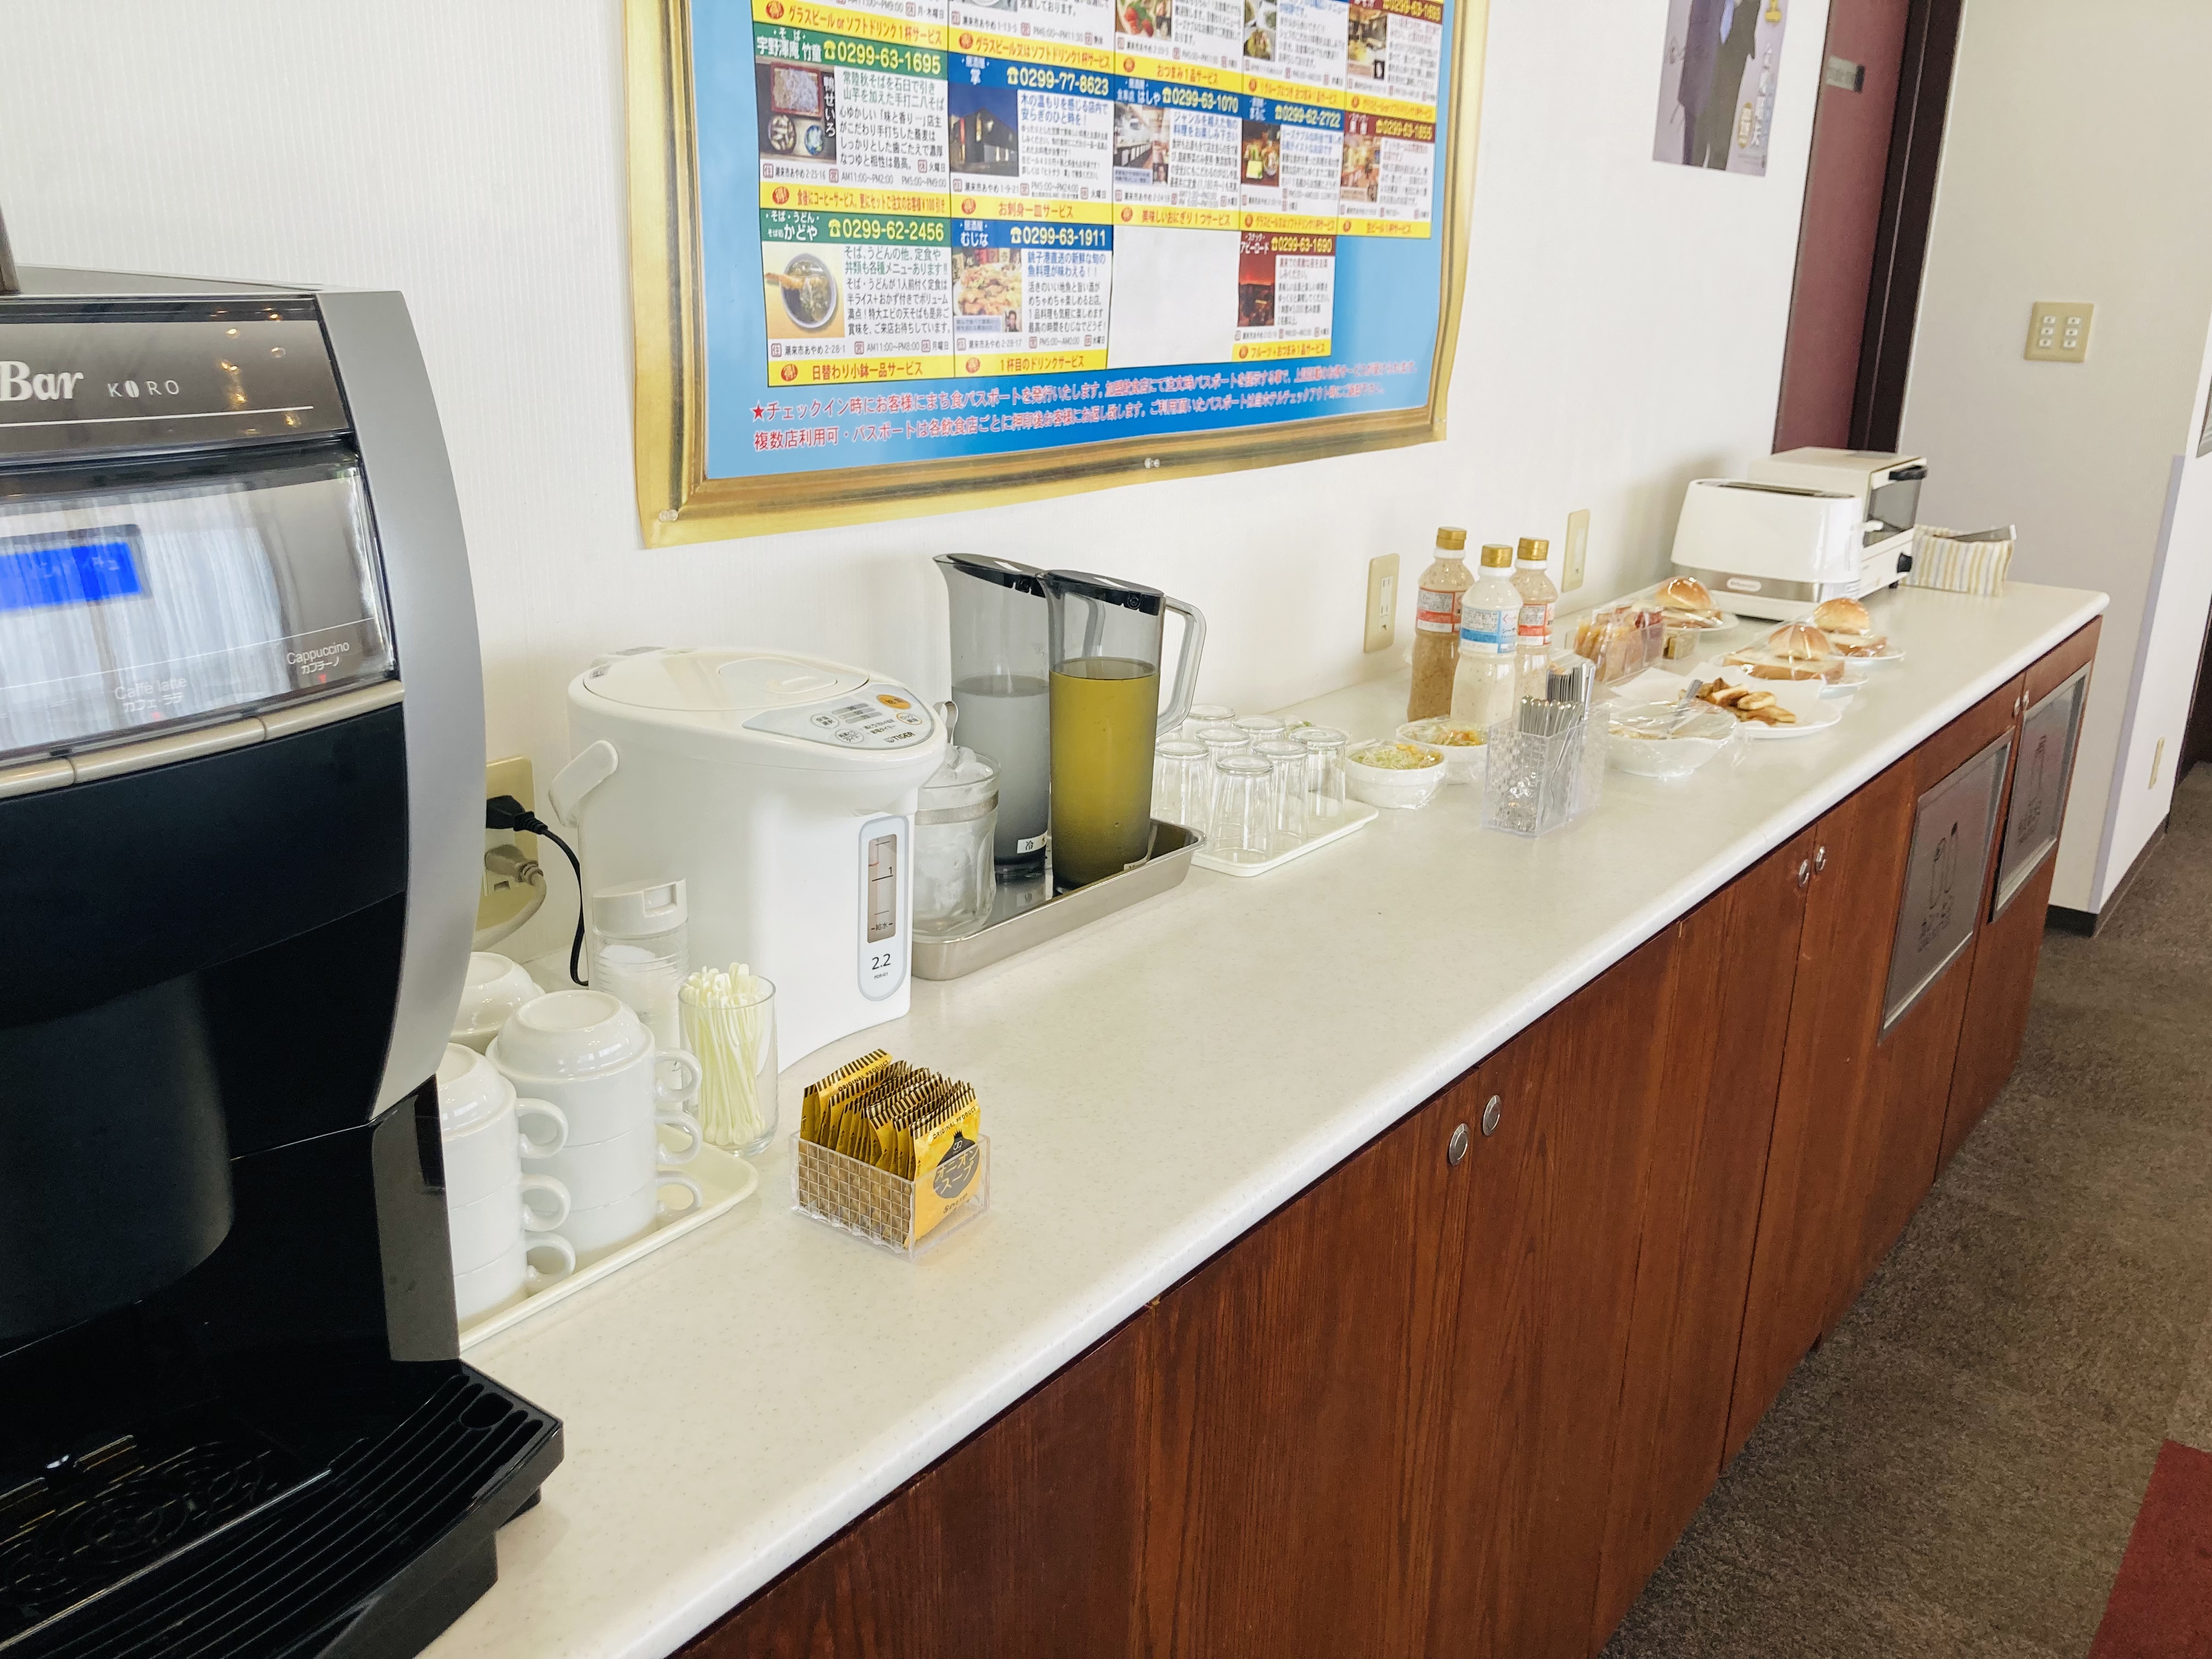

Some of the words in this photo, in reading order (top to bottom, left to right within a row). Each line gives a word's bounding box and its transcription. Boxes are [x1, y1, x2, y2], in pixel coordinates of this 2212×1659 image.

[837, 41, 942, 75] 0299-63-1695
[1020, 66, 1109, 96] 0299-77-8623
[842, 218, 944, 241] 0299-62-2456
[960, 231, 989, 247] むじな
[1023, 225, 1106, 247] 0299-63-1911
[0, 360, 84, 402] Bar
[812, 362, 923, 381] 日替わり小鉢一品サービス
[286, 641, 350, 665] Cappuccino
[892, 731, 916, 741] TIGER
[888, 866, 893, 874] 1
[872, 953, 891, 970] 2.2
[933, 1121, 955, 1139] ORIGINAL
[956, 1106, 977, 1123] PRODUCT
[934, 1147, 979, 1183] オニオン
[940, 1160, 974, 1195] スープ
